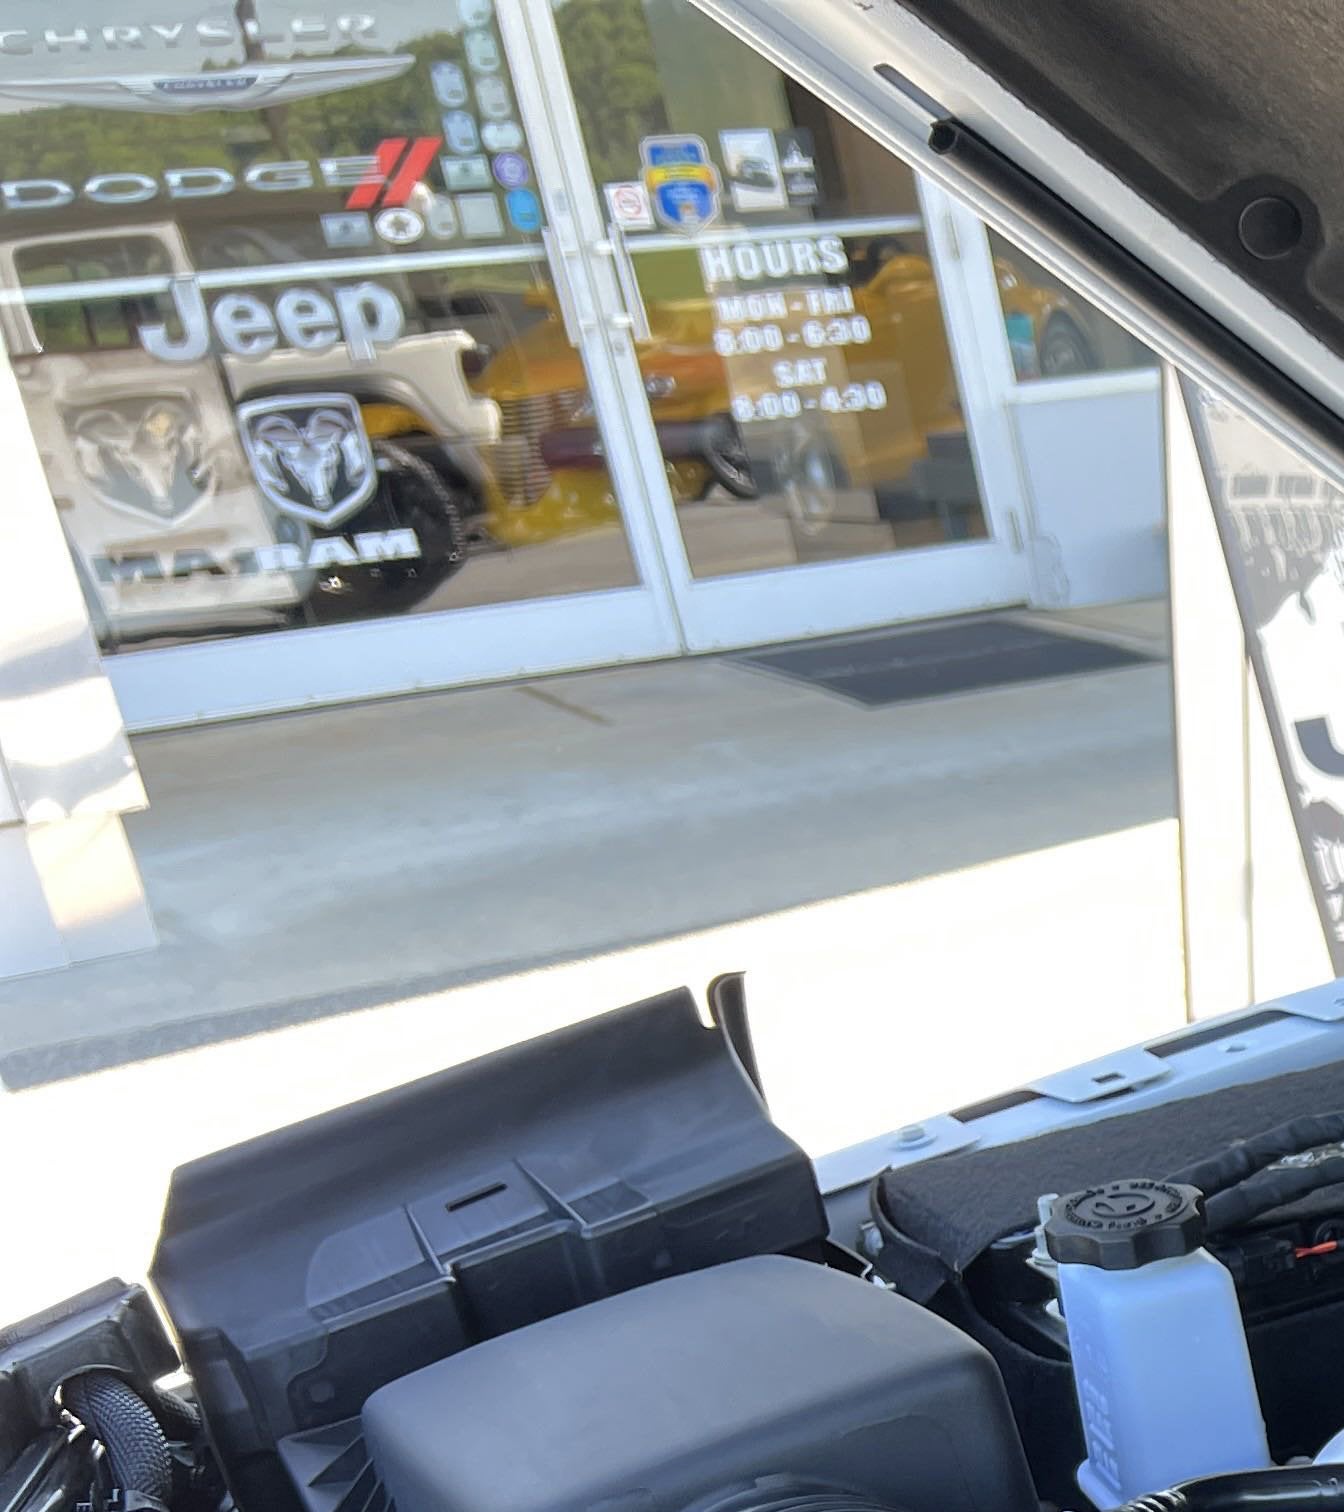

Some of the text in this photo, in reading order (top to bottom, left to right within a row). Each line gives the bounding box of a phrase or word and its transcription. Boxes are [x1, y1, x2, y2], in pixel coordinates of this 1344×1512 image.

[0, 14, 379, 55] CHRYSLER
[0, 154, 384, 209] DODGE
[702, 235, 849, 283] HOURS
[136, 275, 404, 365] Jeep
[255, 528, 421, 572] RAM
